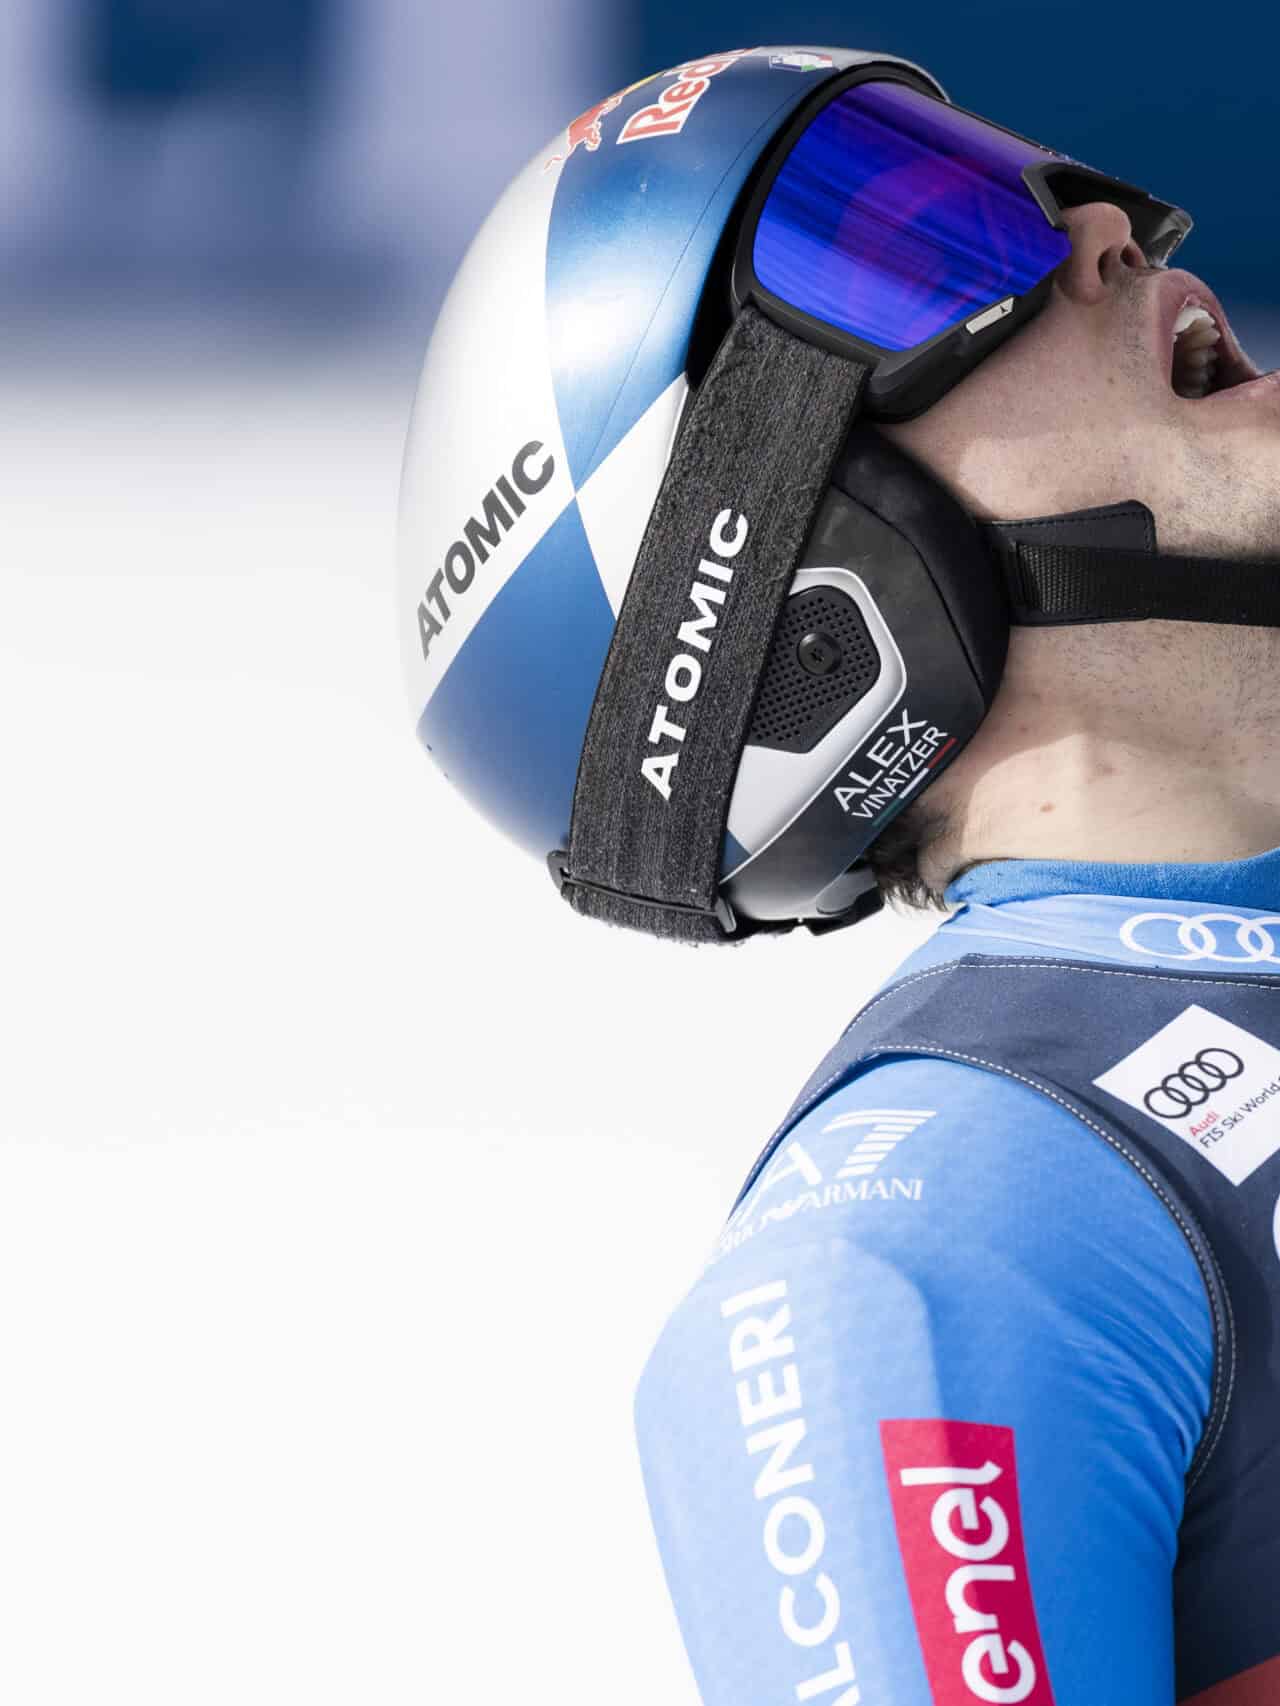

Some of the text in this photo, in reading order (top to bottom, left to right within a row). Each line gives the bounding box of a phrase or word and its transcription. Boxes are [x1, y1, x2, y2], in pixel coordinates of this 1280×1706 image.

[415, 440, 555, 661] ATOMIC
[640, 508, 750, 801] ATOMIC
[833, 708, 928, 812] ALEX
[851, 726, 948, 818] VINATZER
[1189, 1110, 1220, 1137] Audi
[1200, 1127, 1225, 1148] FIS
[1222, 1111, 1245, 1130] Ski
[1240, 1083, 1280, 1113] World
[803, 1177, 924, 1209] ARMANI
[721, 1278, 861, 1706] LCONERI
[900, 1459, 1037, 1704] enel
